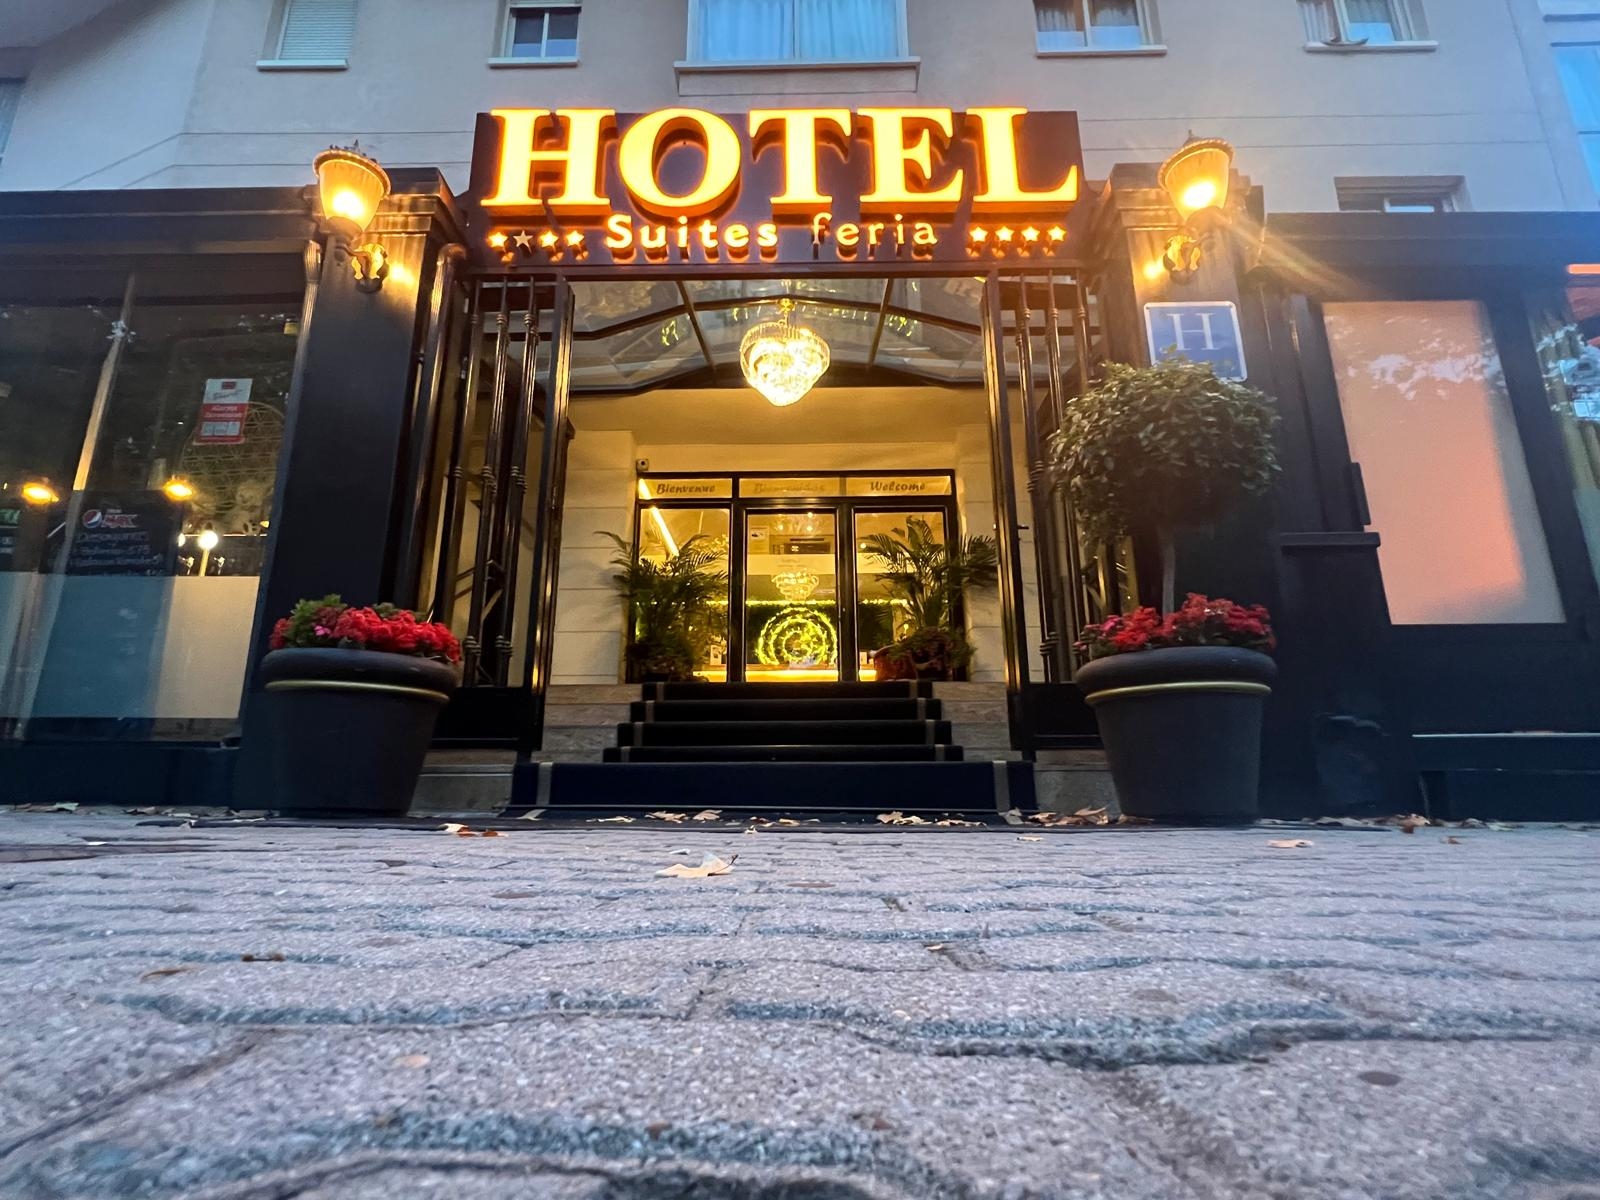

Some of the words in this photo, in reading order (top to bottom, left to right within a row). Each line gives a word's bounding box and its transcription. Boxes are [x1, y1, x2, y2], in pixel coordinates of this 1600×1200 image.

[480, 107, 1079, 208] HOTEL
[605, 213, 778, 249] Suites
[811, 212, 938, 246] feria
[1159, 312, 1220, 351] H
[656, 482, 716, 495] Bienvenue
[870, 481, 926, 492] Welcome
